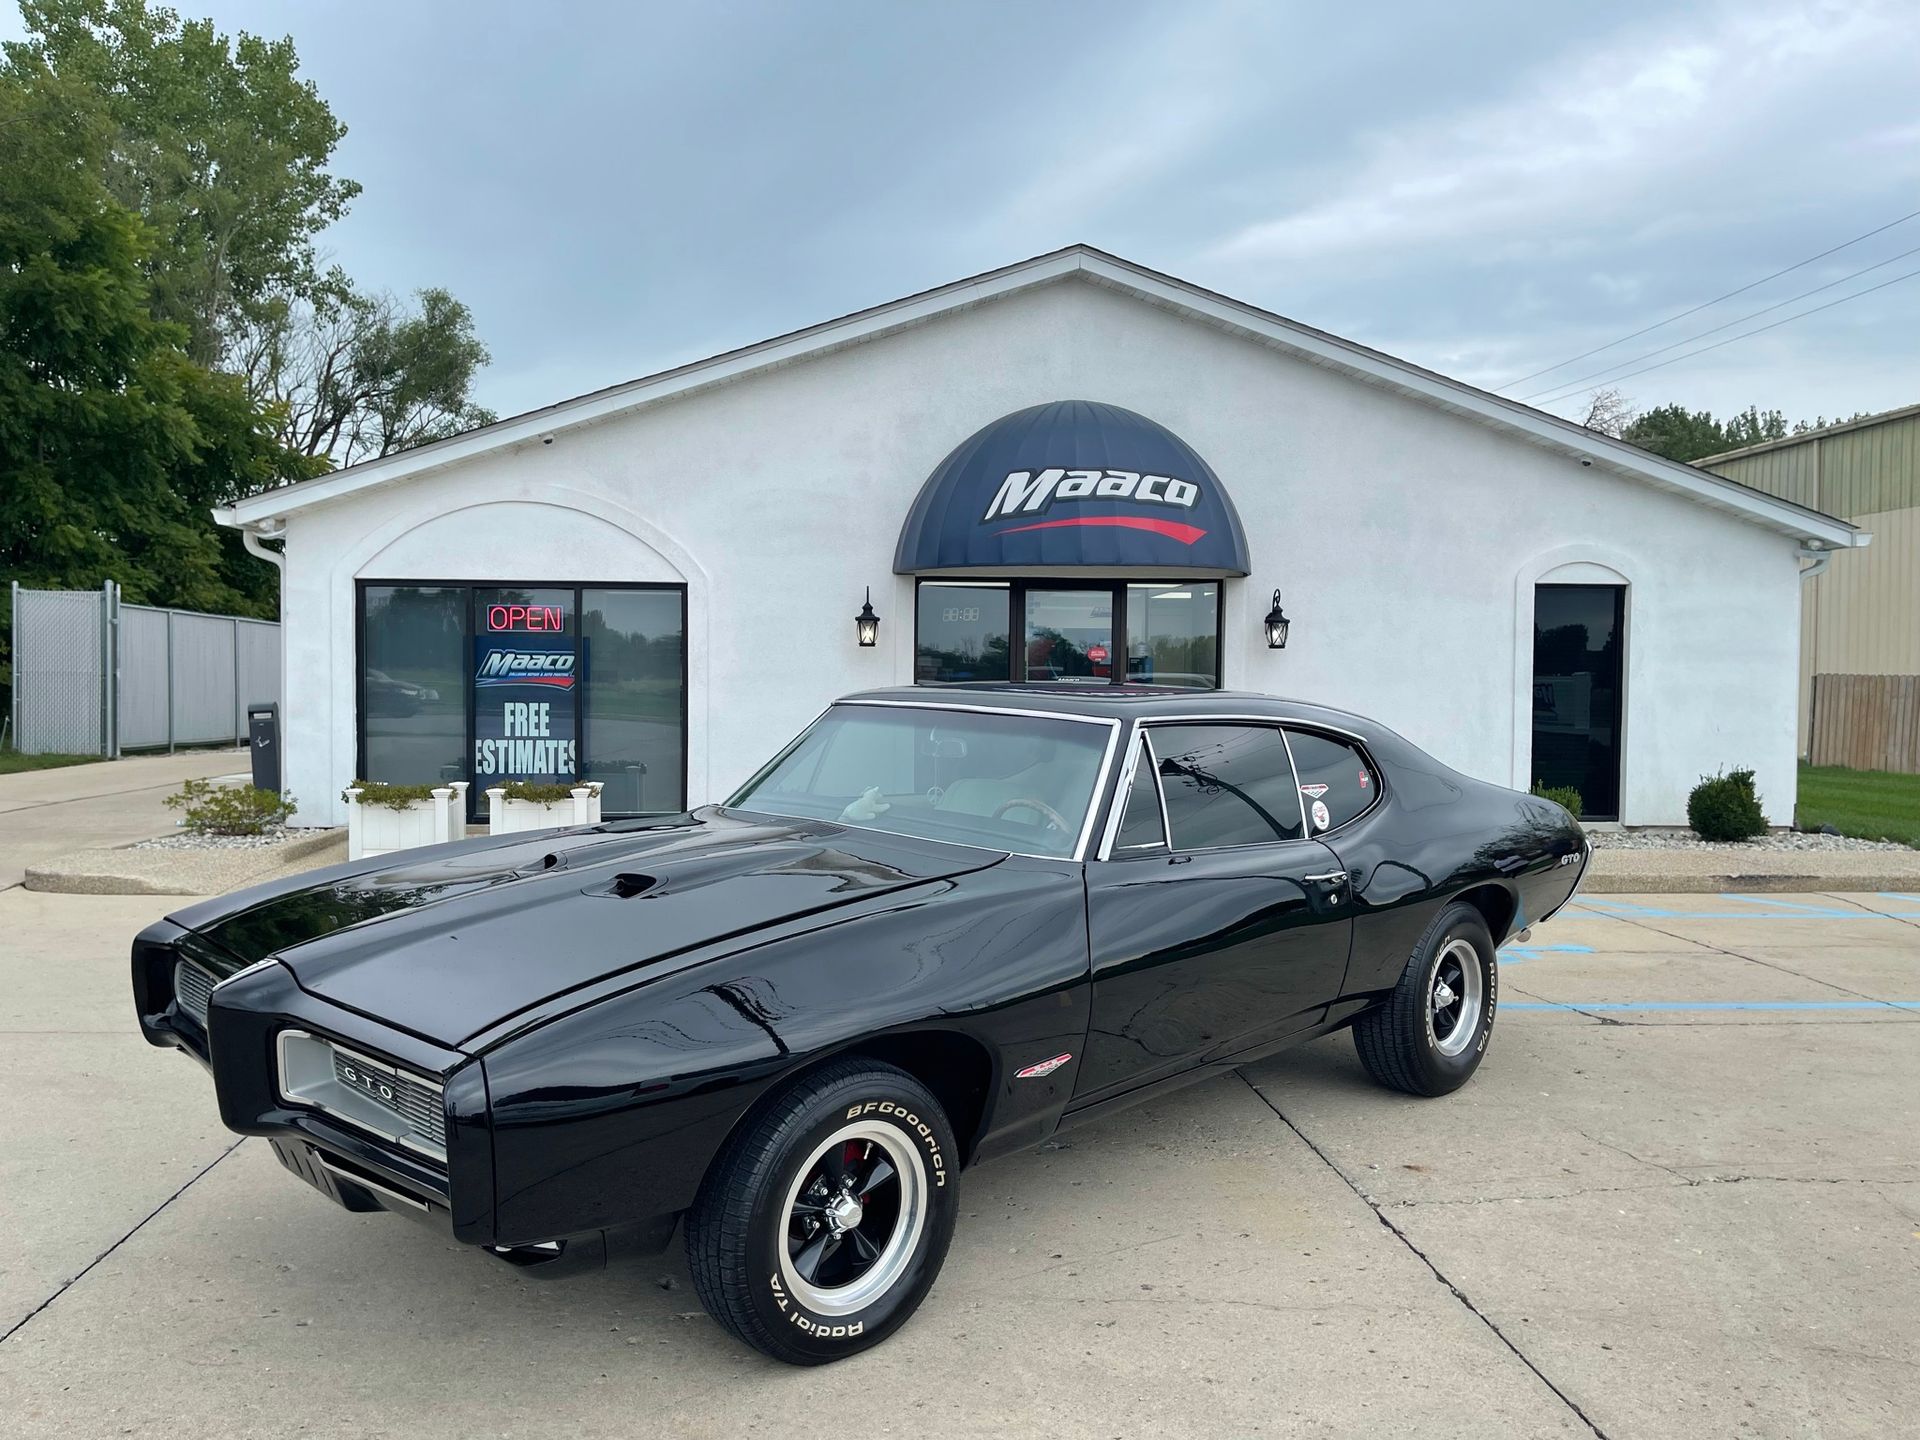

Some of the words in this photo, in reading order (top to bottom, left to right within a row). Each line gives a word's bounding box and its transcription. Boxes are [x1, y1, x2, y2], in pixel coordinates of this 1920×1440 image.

[984, 468, 1198, 520] Maaco
[490, 606, 560, 630] OPEN
[482, 653, 575, 676] Maaco
[504, 702, 550, 736] FREE
[1561, 852, 1580, 865] GTO
[1487, 962, 1496, 1024] Radial
[1477, 1029, 1489, 1052] T/A
[344, 1067, 392, 1099] GTO
[846, 1101, 946, 1187] BFGoodrich
[770, 1272, 789, 1312] T/A
[789, 1311, 864, 1338] Radial
